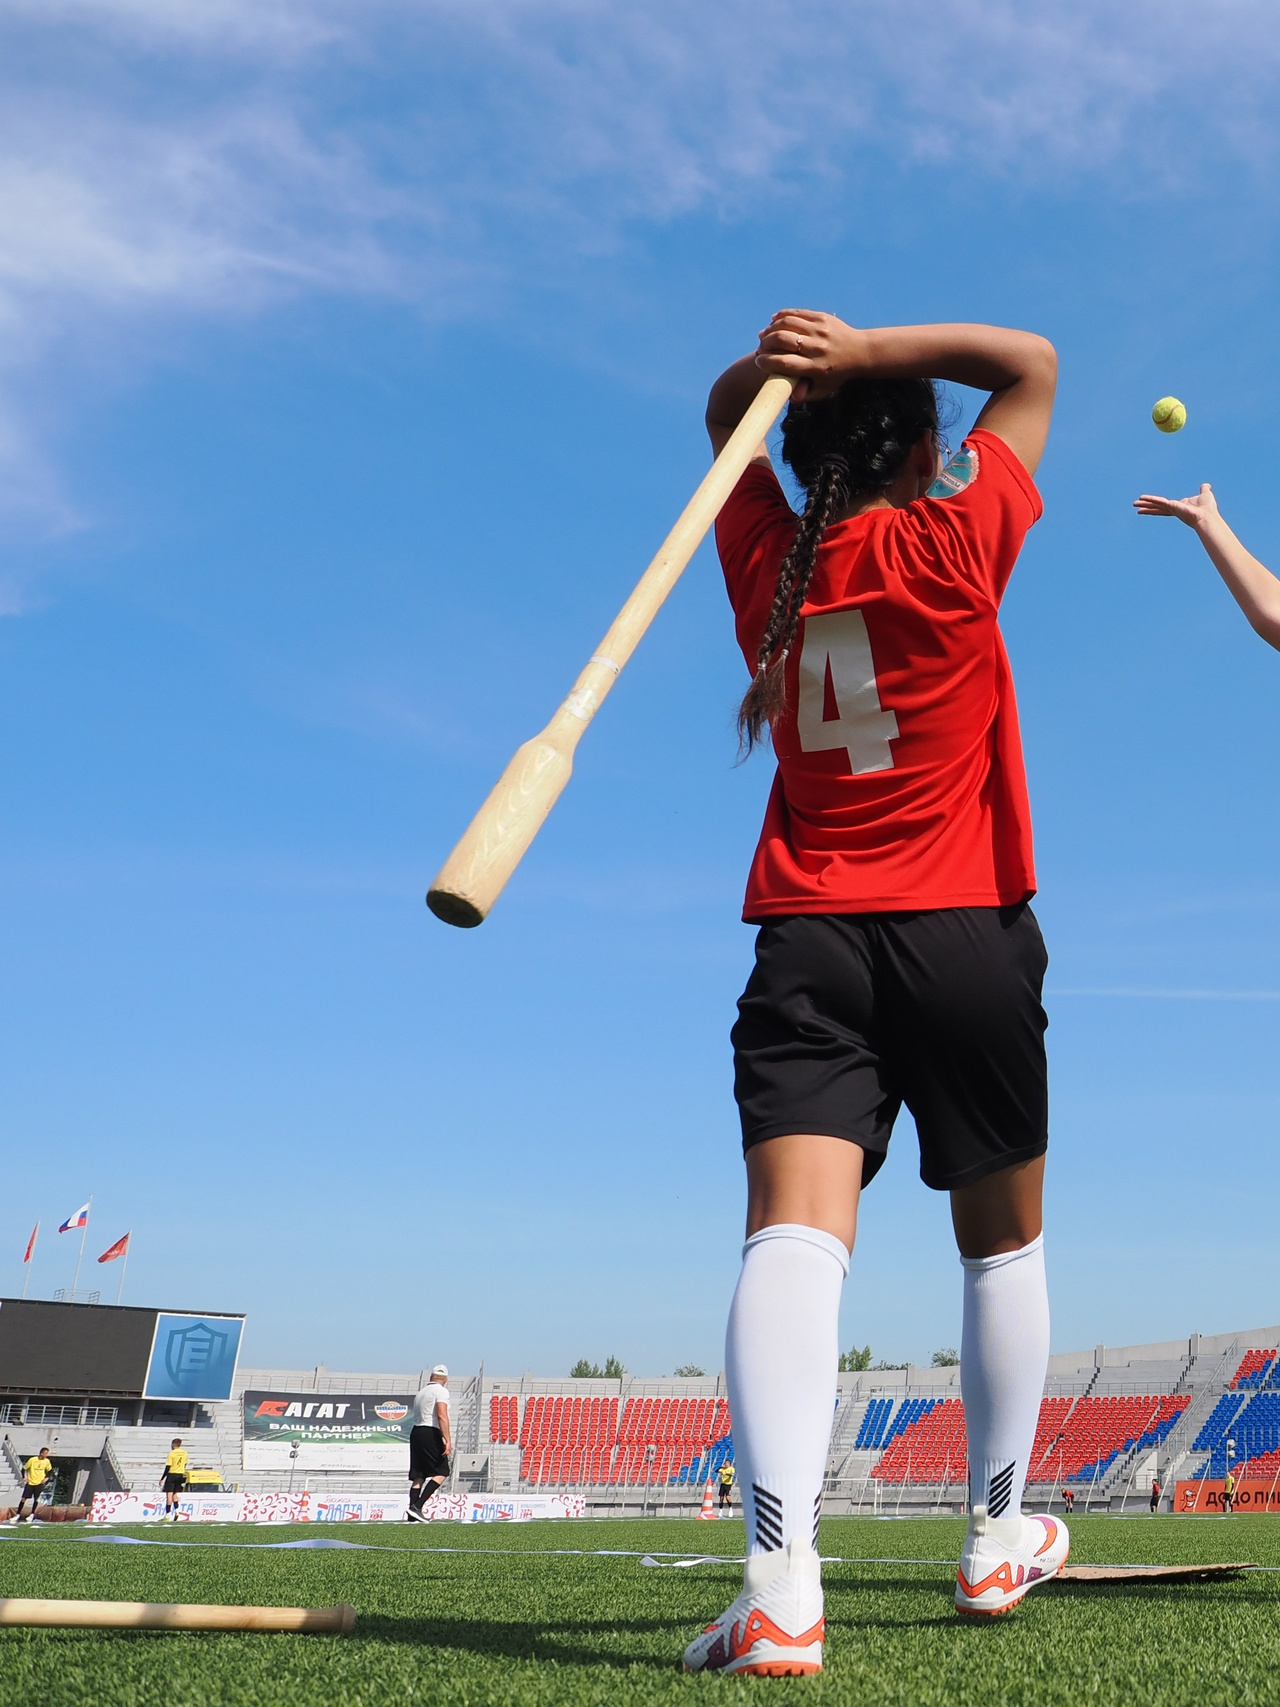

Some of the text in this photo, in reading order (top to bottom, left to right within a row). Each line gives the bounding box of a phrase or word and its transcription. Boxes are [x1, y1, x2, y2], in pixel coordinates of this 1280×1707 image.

[797, 609, 900, 775] 4
[284, 1402, 350, 1419] АГАТ
[269, 1423, 402, 1432] ВАШ НАДЕЖНЫЙ
[301, 1432, 373, 1440] ПАРТНЕР
